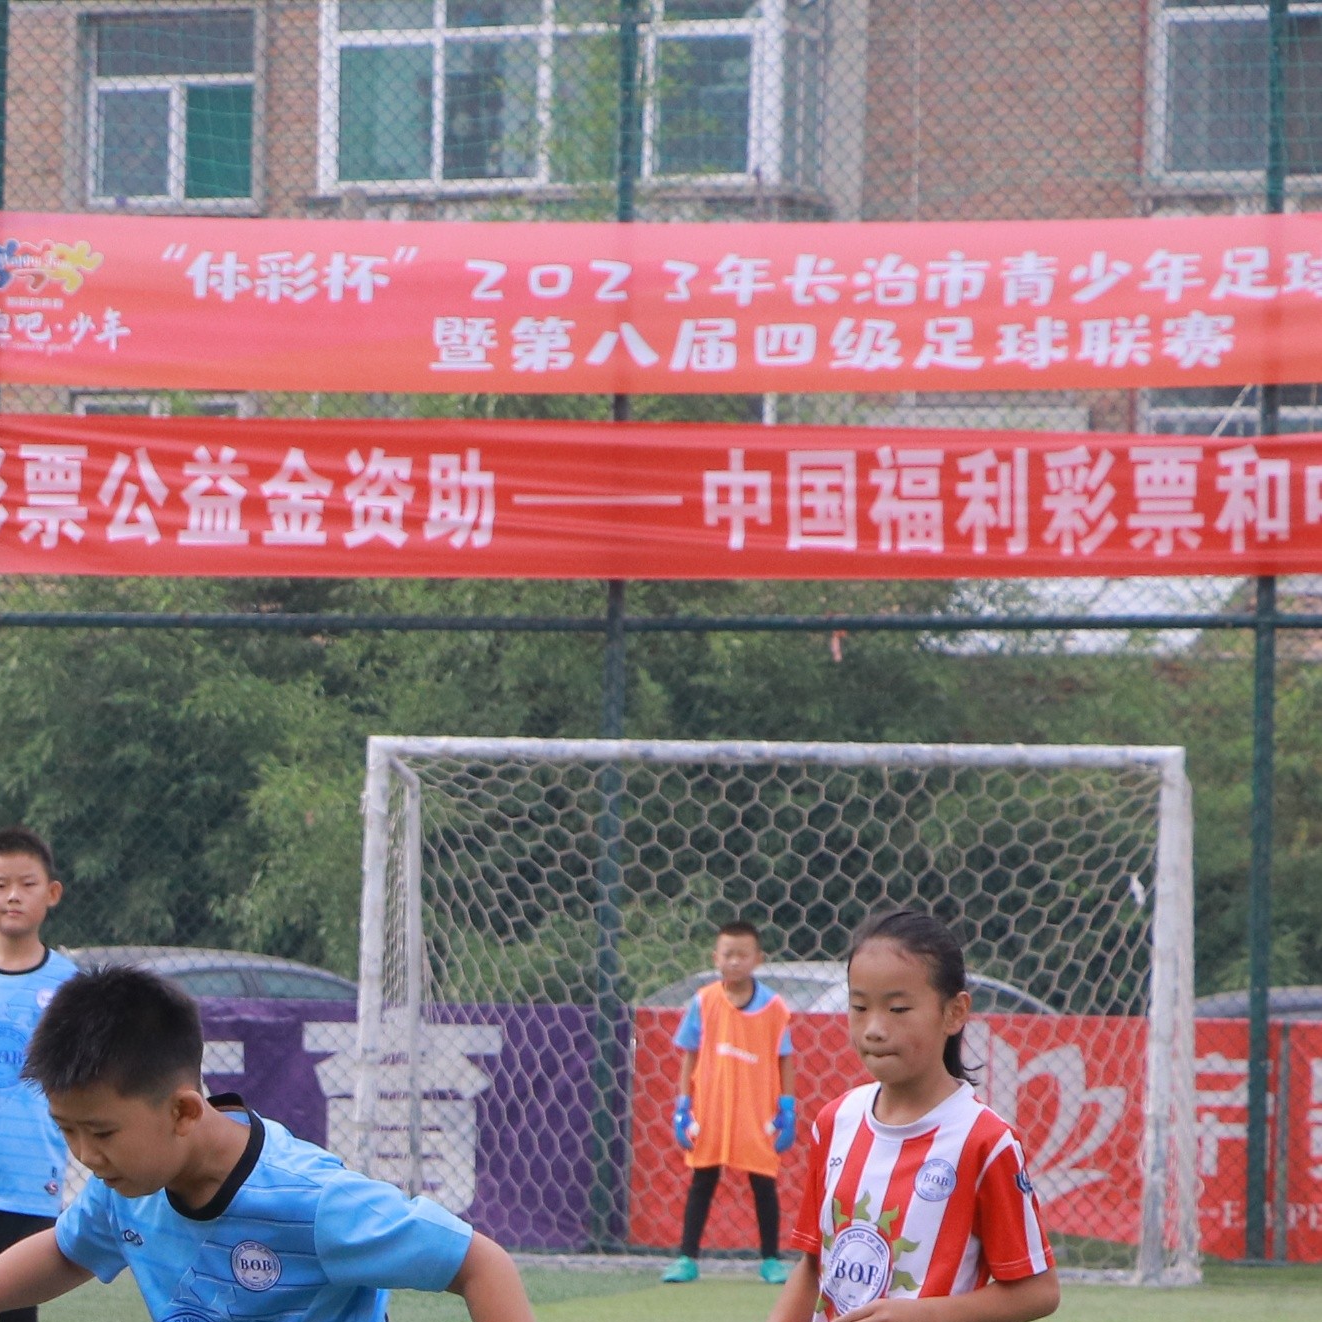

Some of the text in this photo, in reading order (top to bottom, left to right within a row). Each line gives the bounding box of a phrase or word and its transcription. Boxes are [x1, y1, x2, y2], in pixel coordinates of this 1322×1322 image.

[429, 310, 1235, 373] 暨第八届四级足球联赛
[240, 1258, 272, 1271] BOB
